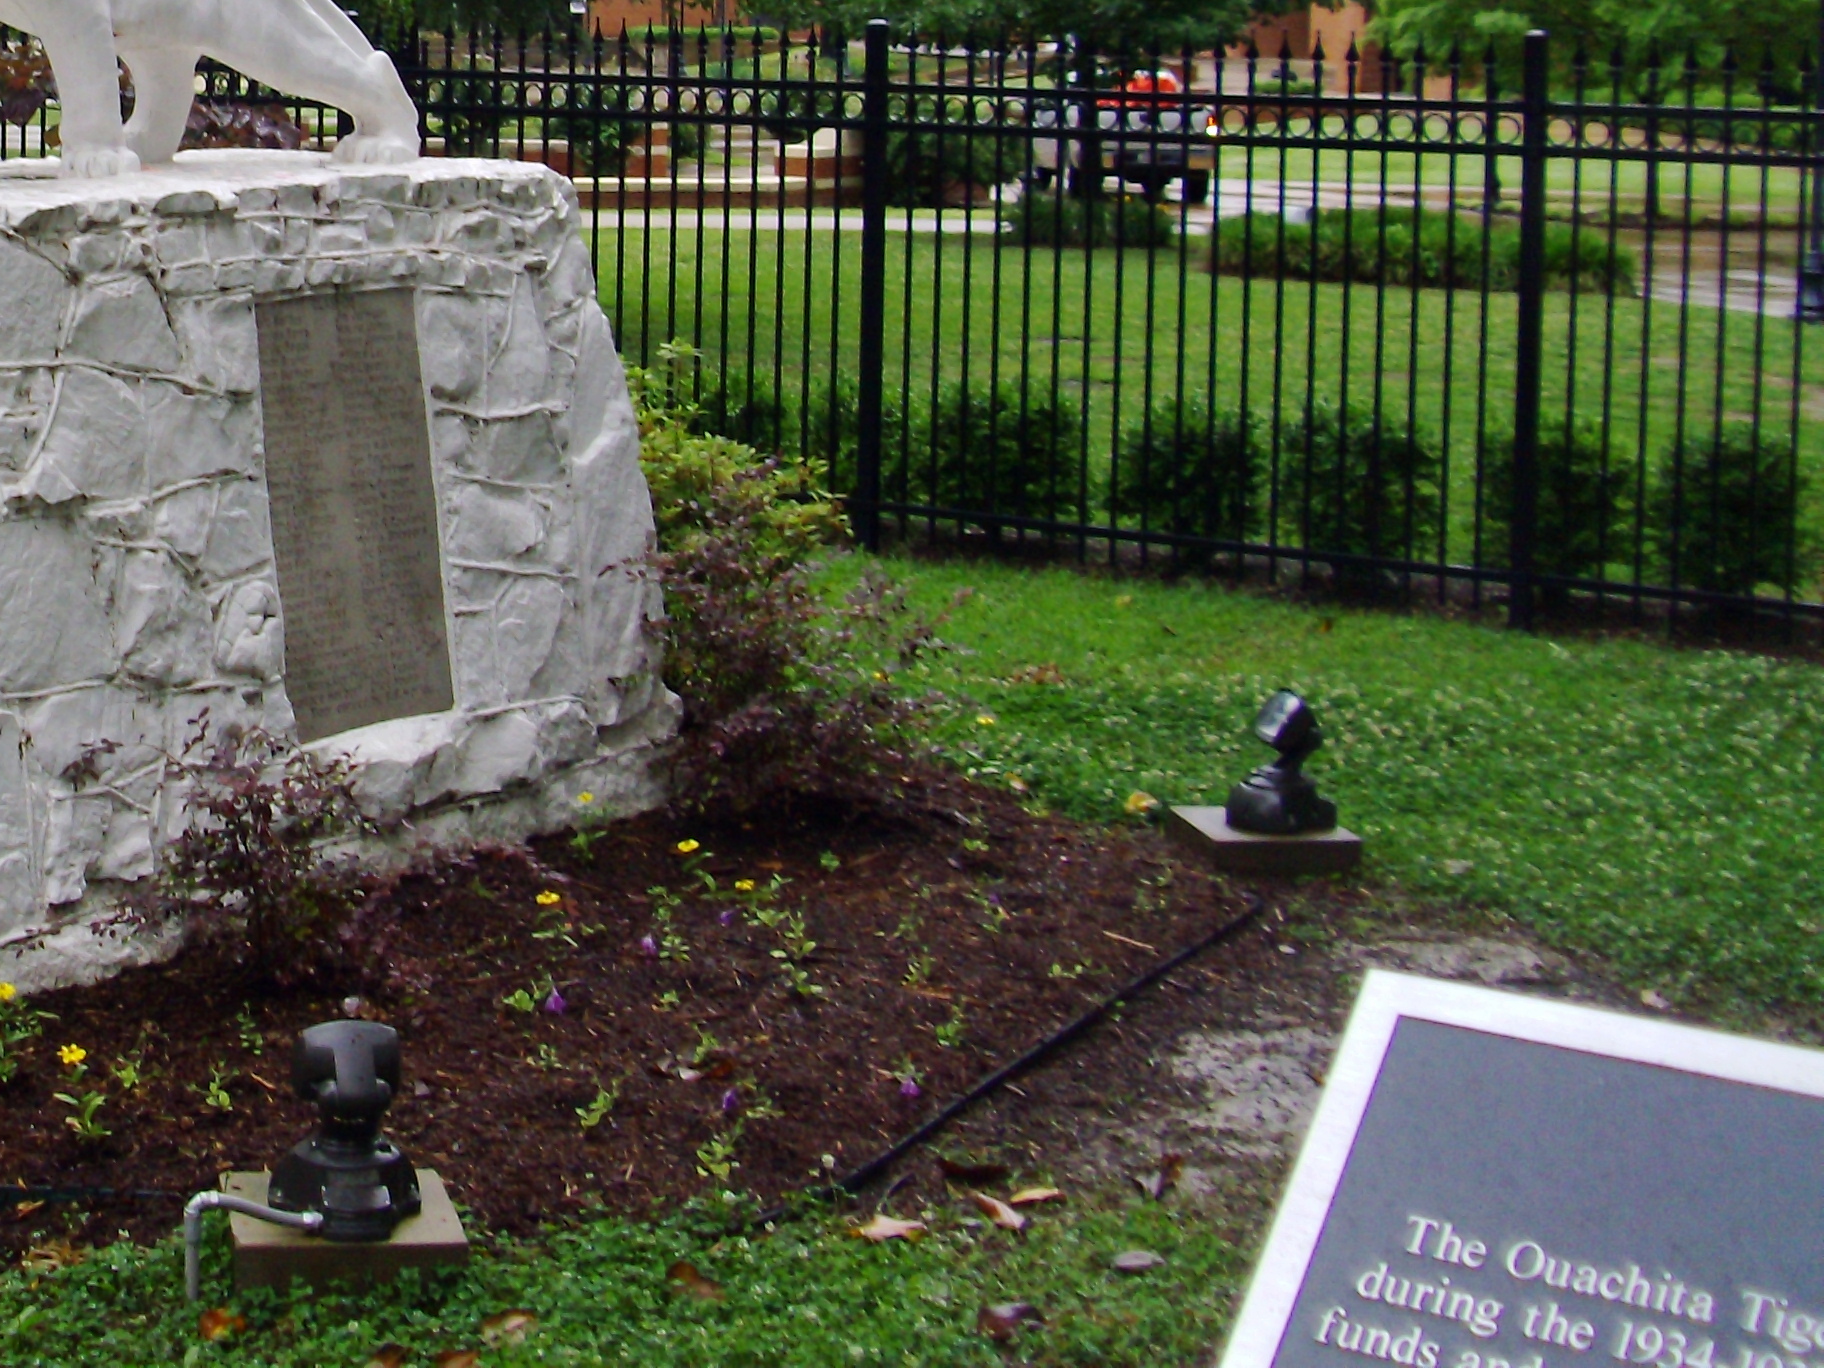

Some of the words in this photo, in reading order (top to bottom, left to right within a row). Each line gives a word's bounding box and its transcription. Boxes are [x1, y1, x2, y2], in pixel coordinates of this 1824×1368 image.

[1355, 1262, 1505, 1338] during
[1524, 1301, 1594, 1351] the
[1406, 1215, 1488, 1268] The
[1505, 1240, 1714, 1322] Ouachita
[1313, 1305, 1441, 1368] funds
